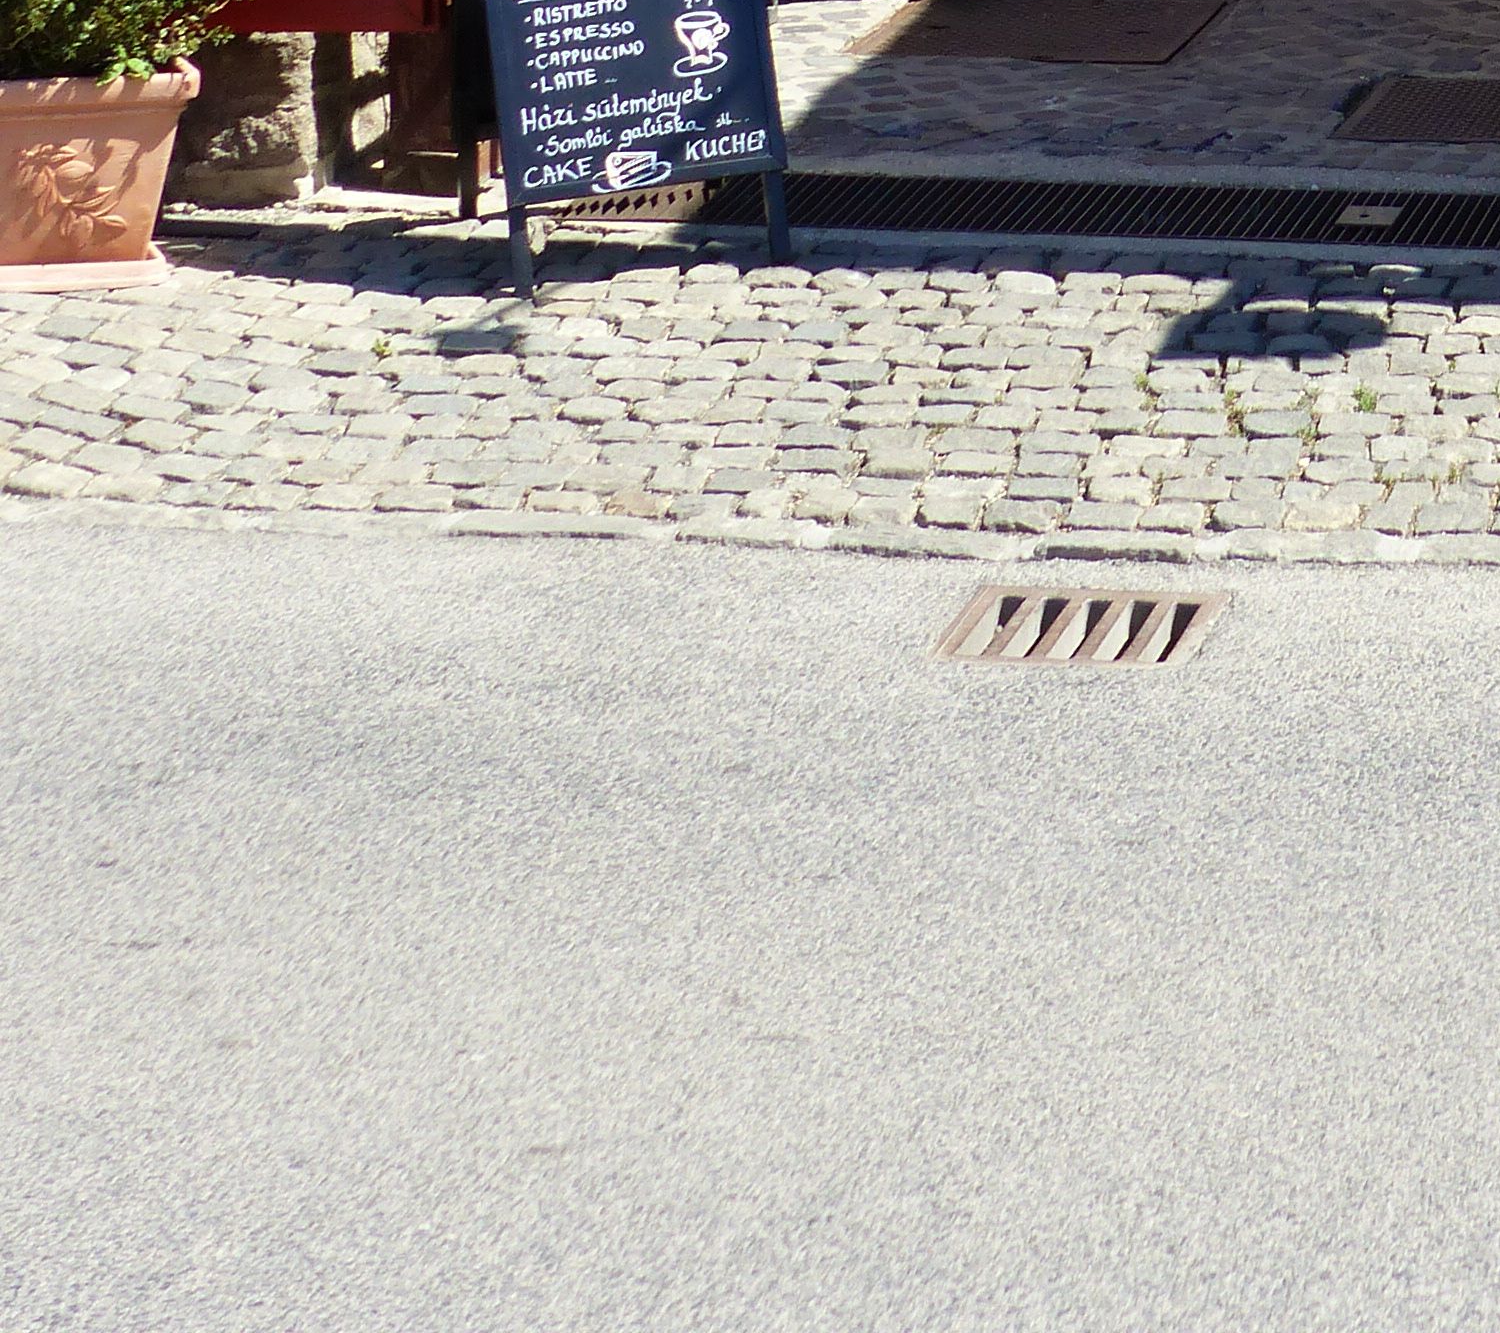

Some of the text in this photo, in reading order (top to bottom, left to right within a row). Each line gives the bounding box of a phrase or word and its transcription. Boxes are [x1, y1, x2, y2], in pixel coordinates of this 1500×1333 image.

[535, 21, 635, 50] ESPRESSO
[535, 40, 645, 70] CAPPUCCINO
[540, 68, 597, 93] LATTE
[521, 102, 578, 136] Házi
[524, 156, 594, 188] CAKE
